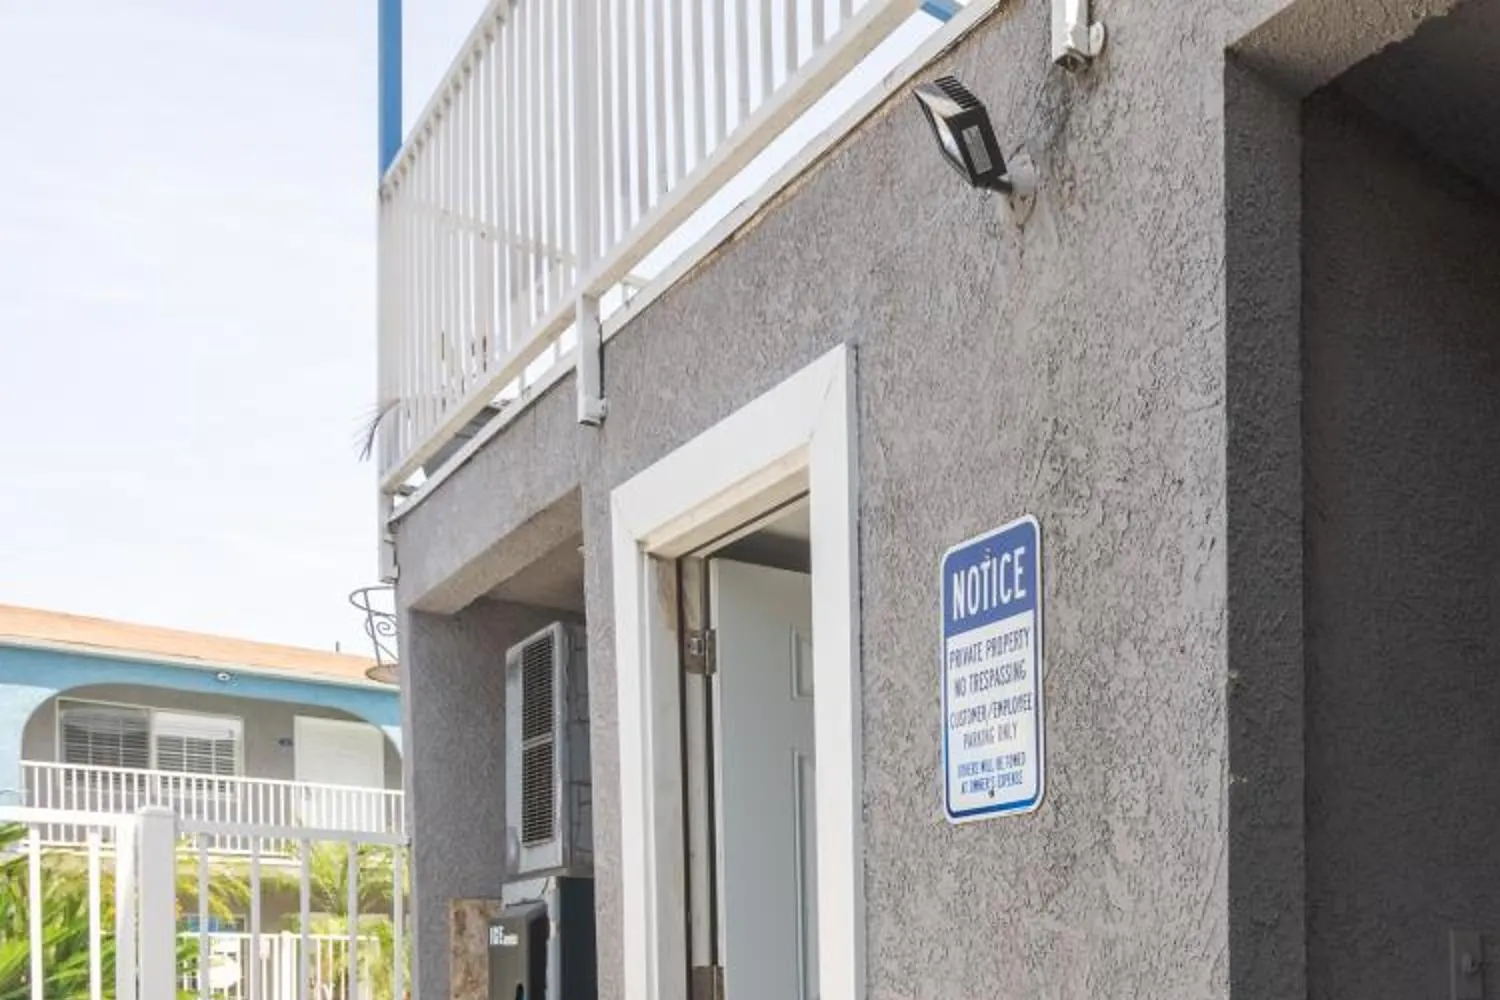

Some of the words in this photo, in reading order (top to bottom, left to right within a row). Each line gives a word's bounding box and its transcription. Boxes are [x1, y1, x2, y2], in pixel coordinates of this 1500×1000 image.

[953, 546, 1027, 621] NOTICE
[949, 641, 983, 670] PRIVATE
[986, 626, 1030, 660] PROPERTY
[955, 676, 967, 697] NO
[969, 658, 1027, 693] TRESPASSING
